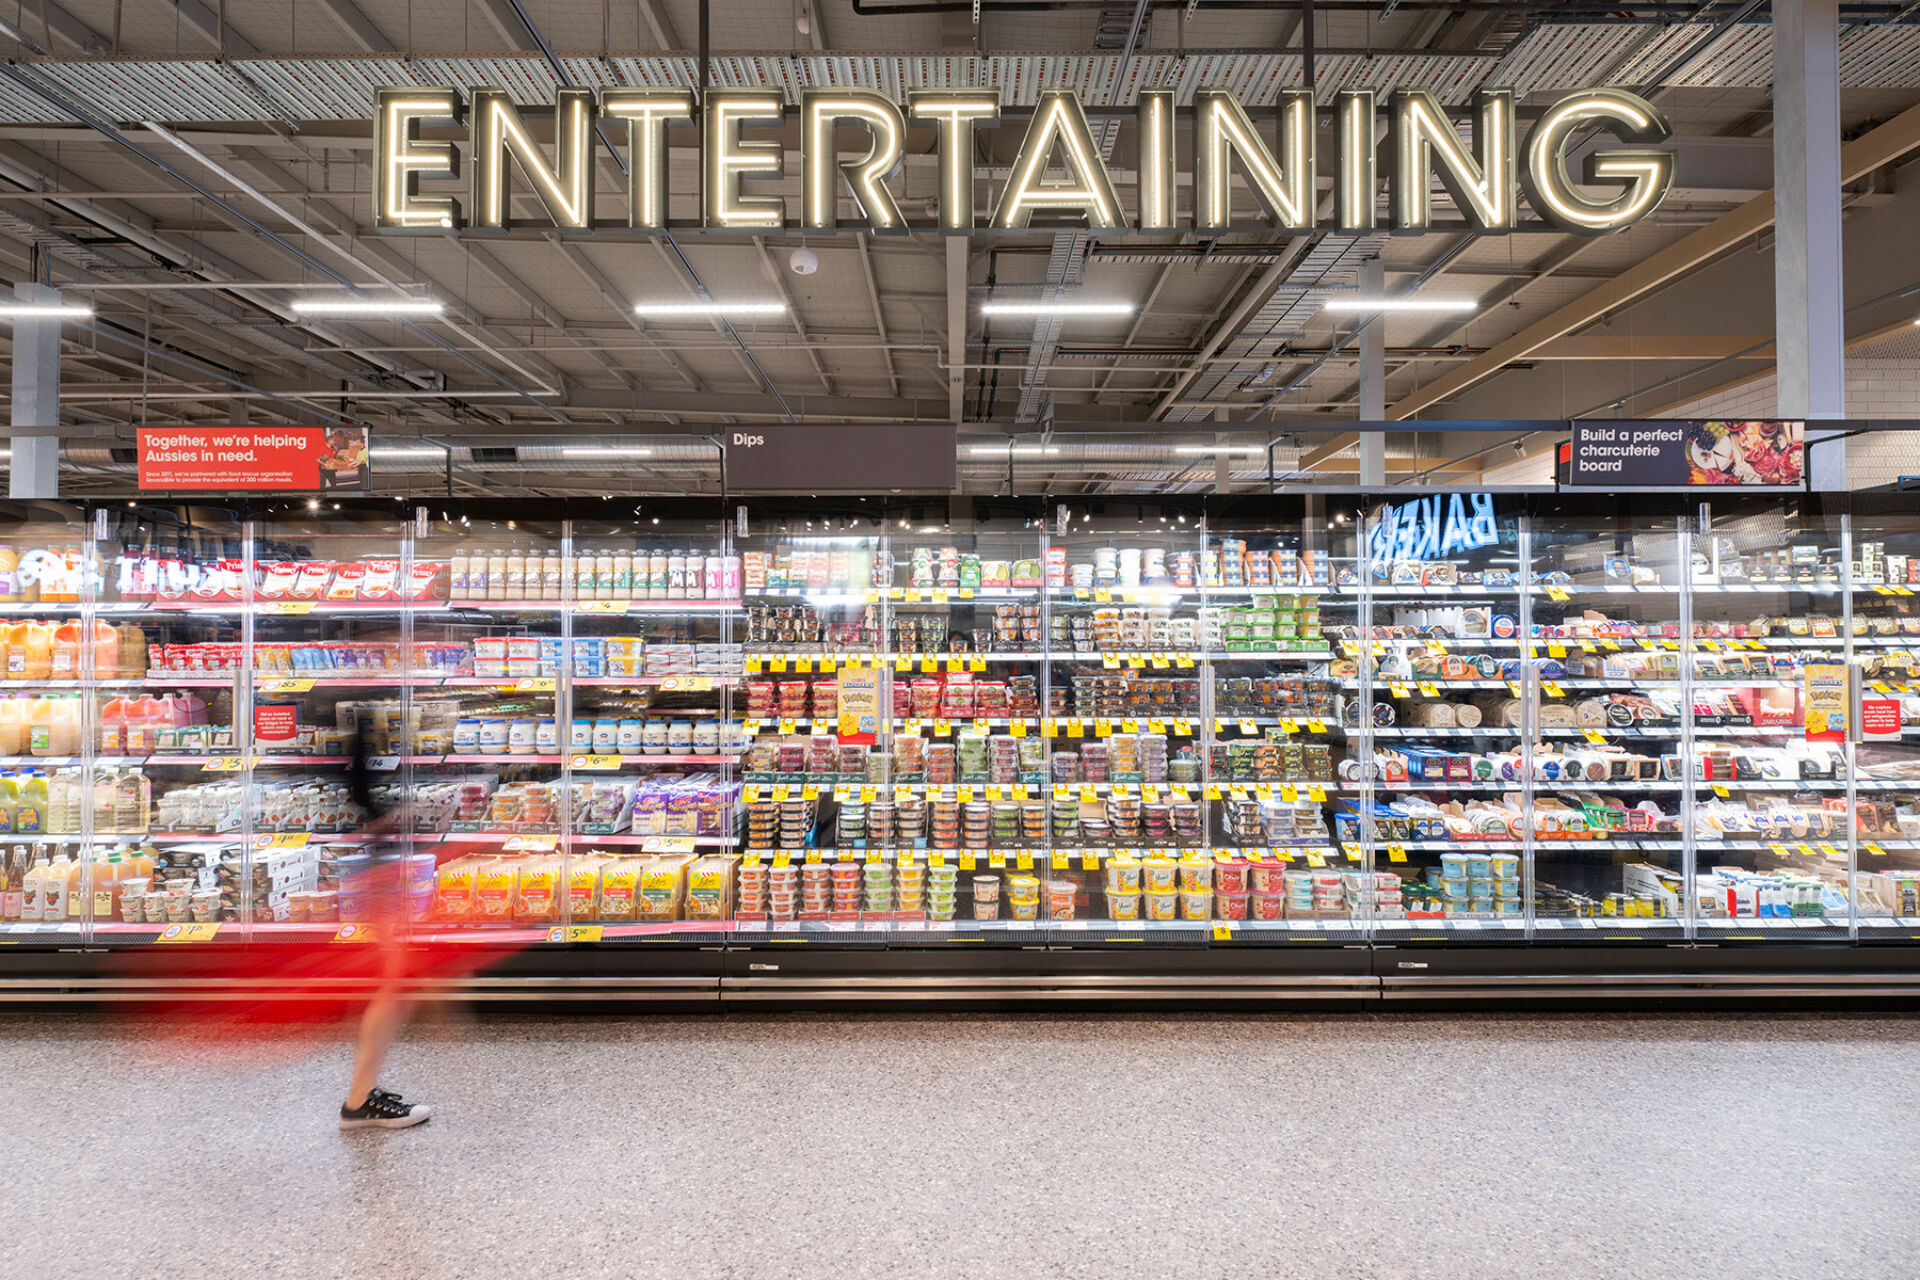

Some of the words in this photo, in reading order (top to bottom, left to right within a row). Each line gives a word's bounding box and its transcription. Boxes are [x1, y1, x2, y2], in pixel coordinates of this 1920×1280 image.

[373, 86, 1674, 234] ENTERTAINING
[144, 434, 209, 450] Together,
[213, 434, 250, 447] we’re
[254, 434, 307, 450] helping
[733, 432, 765, 448] Dips
[1580, 429, 1615, 441] Build
[1619, 431, 1630, 442] a
[1633, 429, 1684, 444] perfect
[145, 450, 199, 462] Aussies
[201, 450, 214, 462] in
[217, 450, 258, 462] need.
[1579, 444, 1661, 457] charcuterie
[1579, 459, 1622, 472] board
